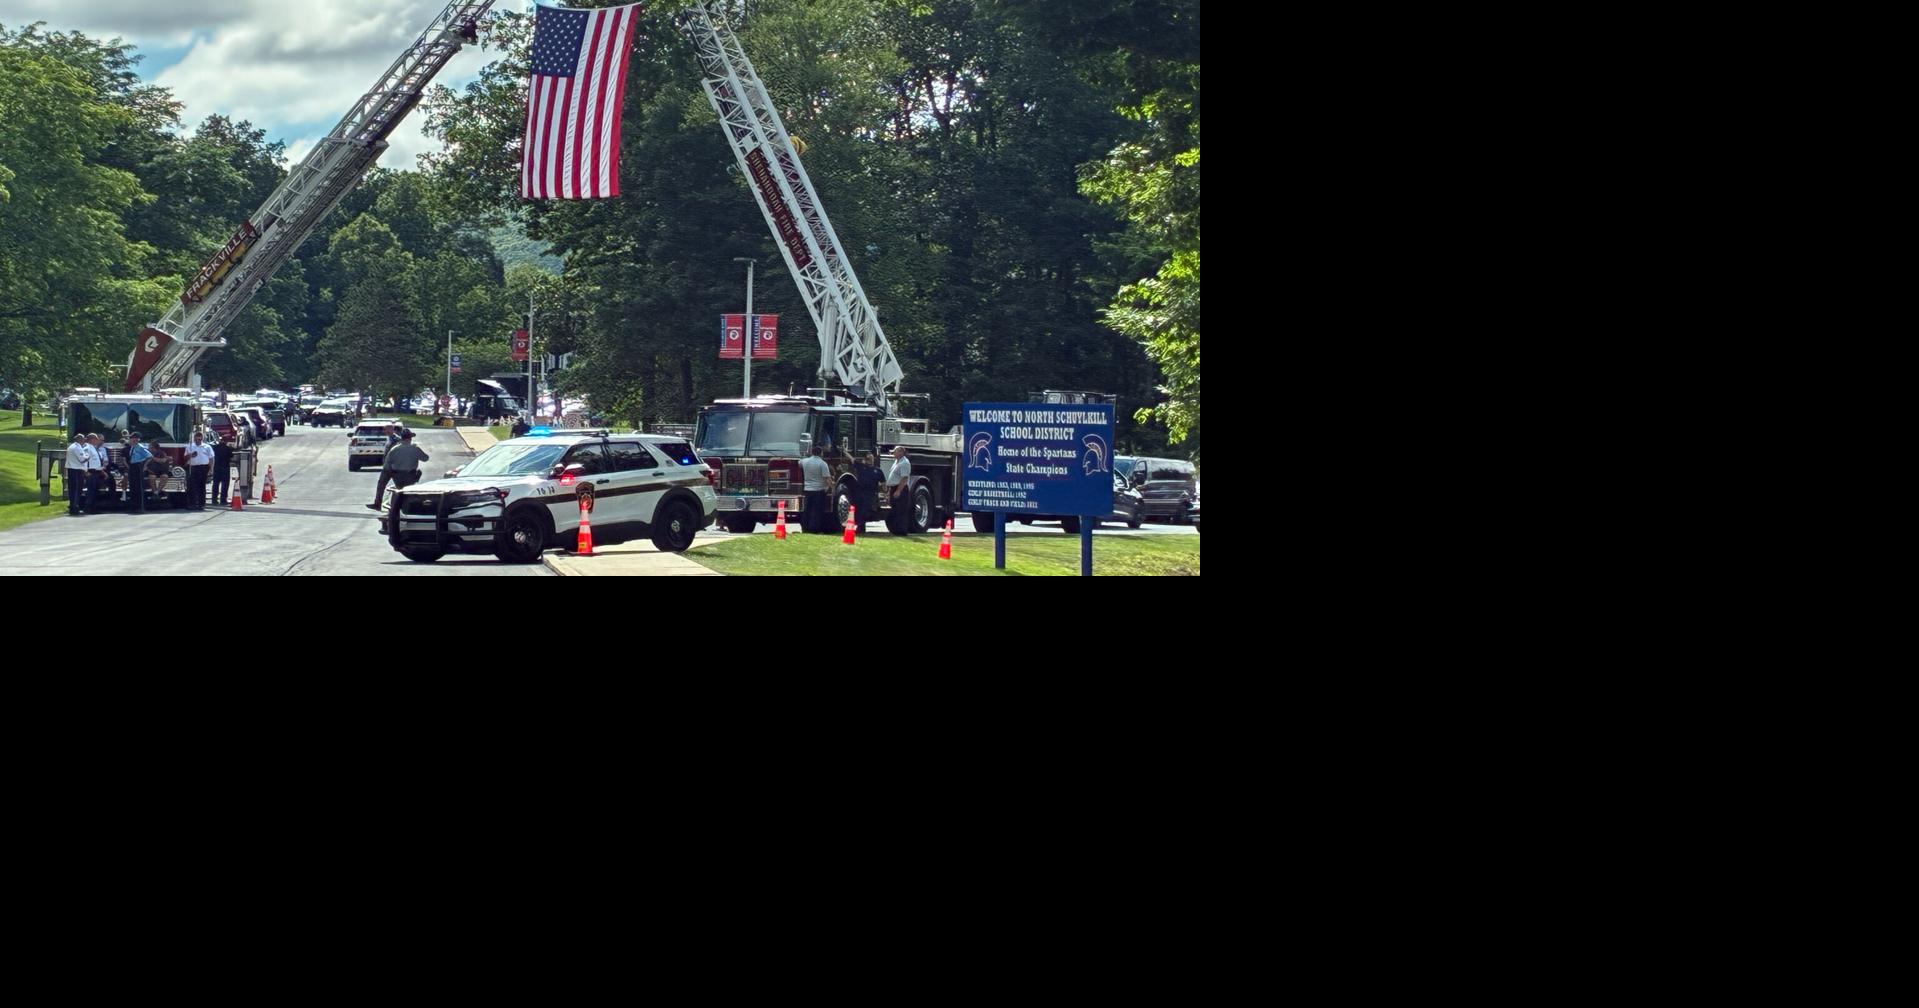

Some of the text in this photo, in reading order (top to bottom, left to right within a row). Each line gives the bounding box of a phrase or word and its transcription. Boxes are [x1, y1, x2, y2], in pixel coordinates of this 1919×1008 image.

[750, 152, 807, 262] SHENANDOAH FIRE DEPT
[186, 229, 247, 299] FRACKVILLE
[969, 410, 1107, 425] WELCOME TO NORTH SCHUYLKILL
[1000, 426, 1074, 441] SCHOOL DISTRICT
[998, 445, 1077, 460] Home of the Spartans
[1006, 462, 1068, 477] State Champions
